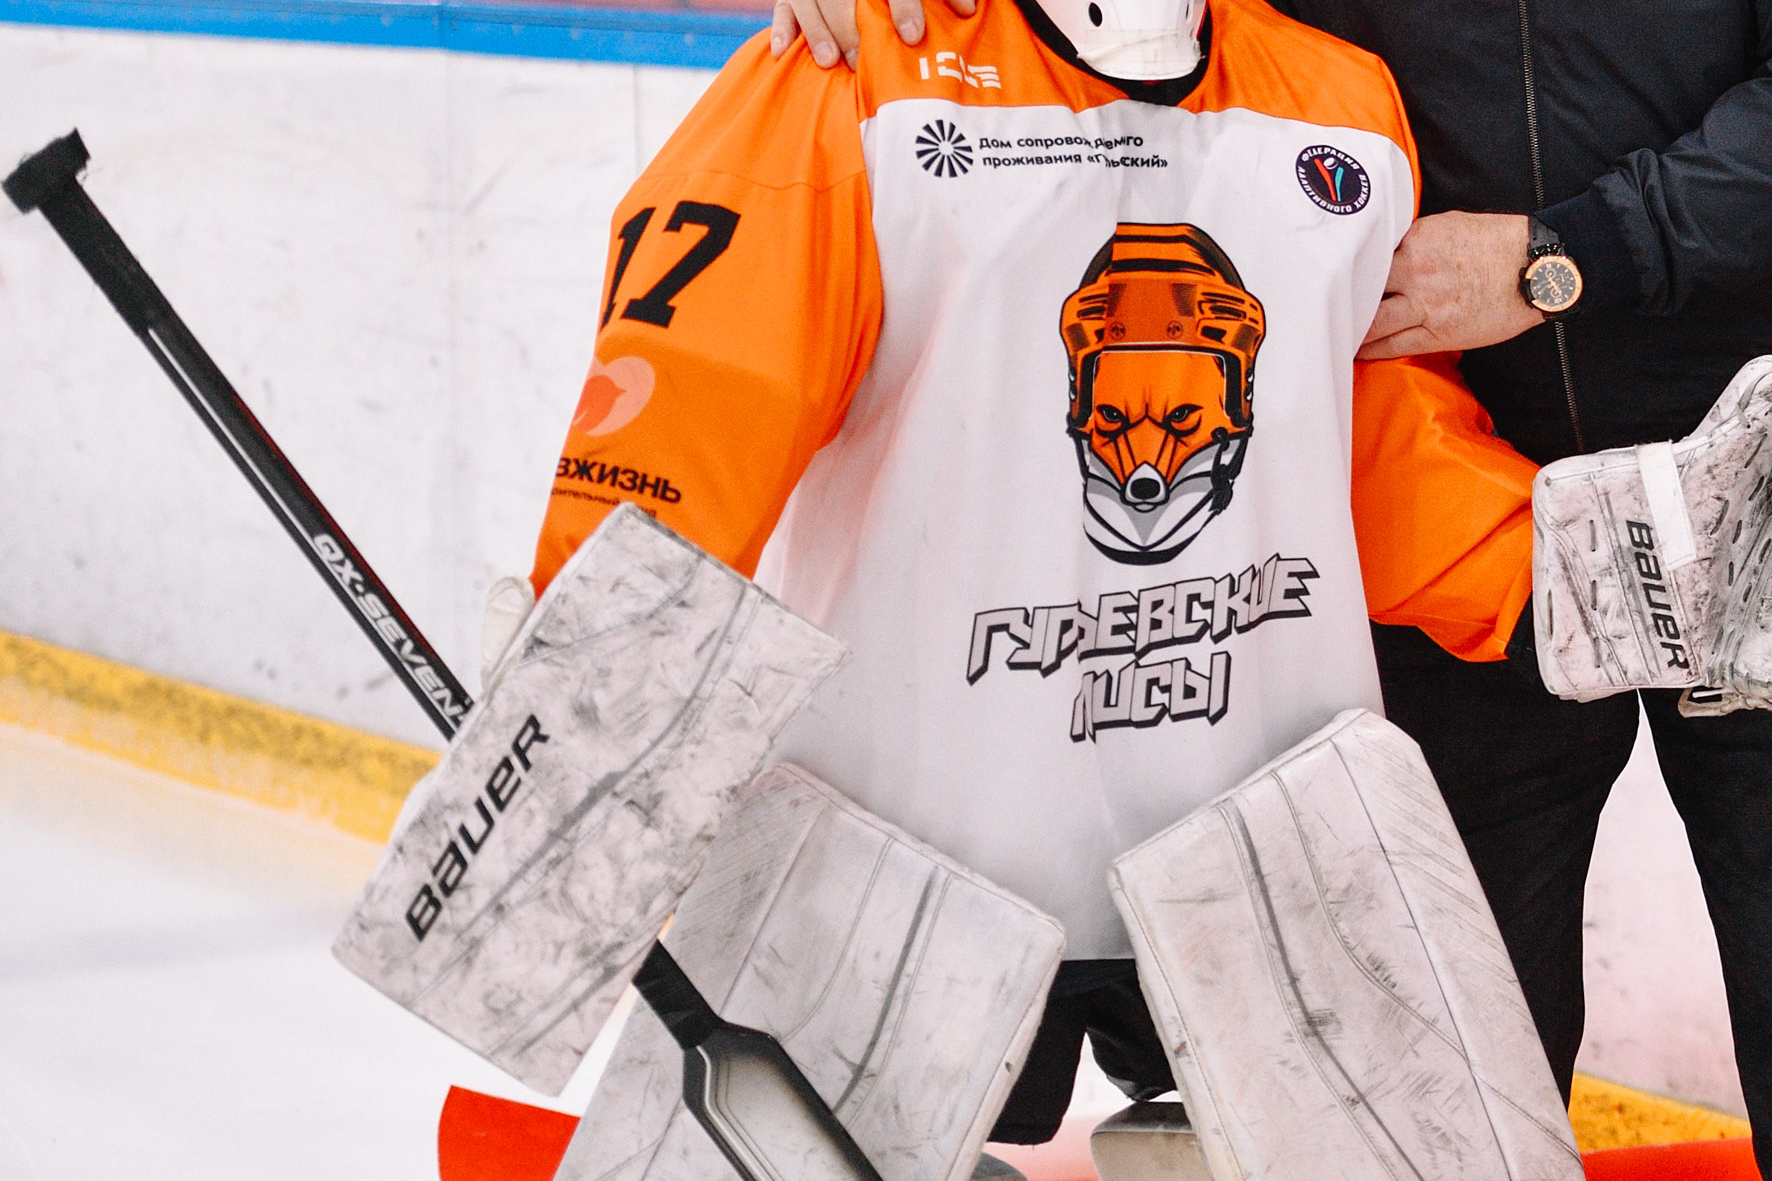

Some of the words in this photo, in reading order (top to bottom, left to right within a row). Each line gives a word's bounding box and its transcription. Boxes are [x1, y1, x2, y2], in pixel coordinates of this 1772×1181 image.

[979, 137, 1012, 150] Дом
[982, 153, 1082, 169] проживания
[599, 200, 742, 332] 17
[1626, 520, 1690, 670] BAUER
[1069, 650, 1232, 743] ЛИСЫ
[405, 714, 550, 942] BAUER
